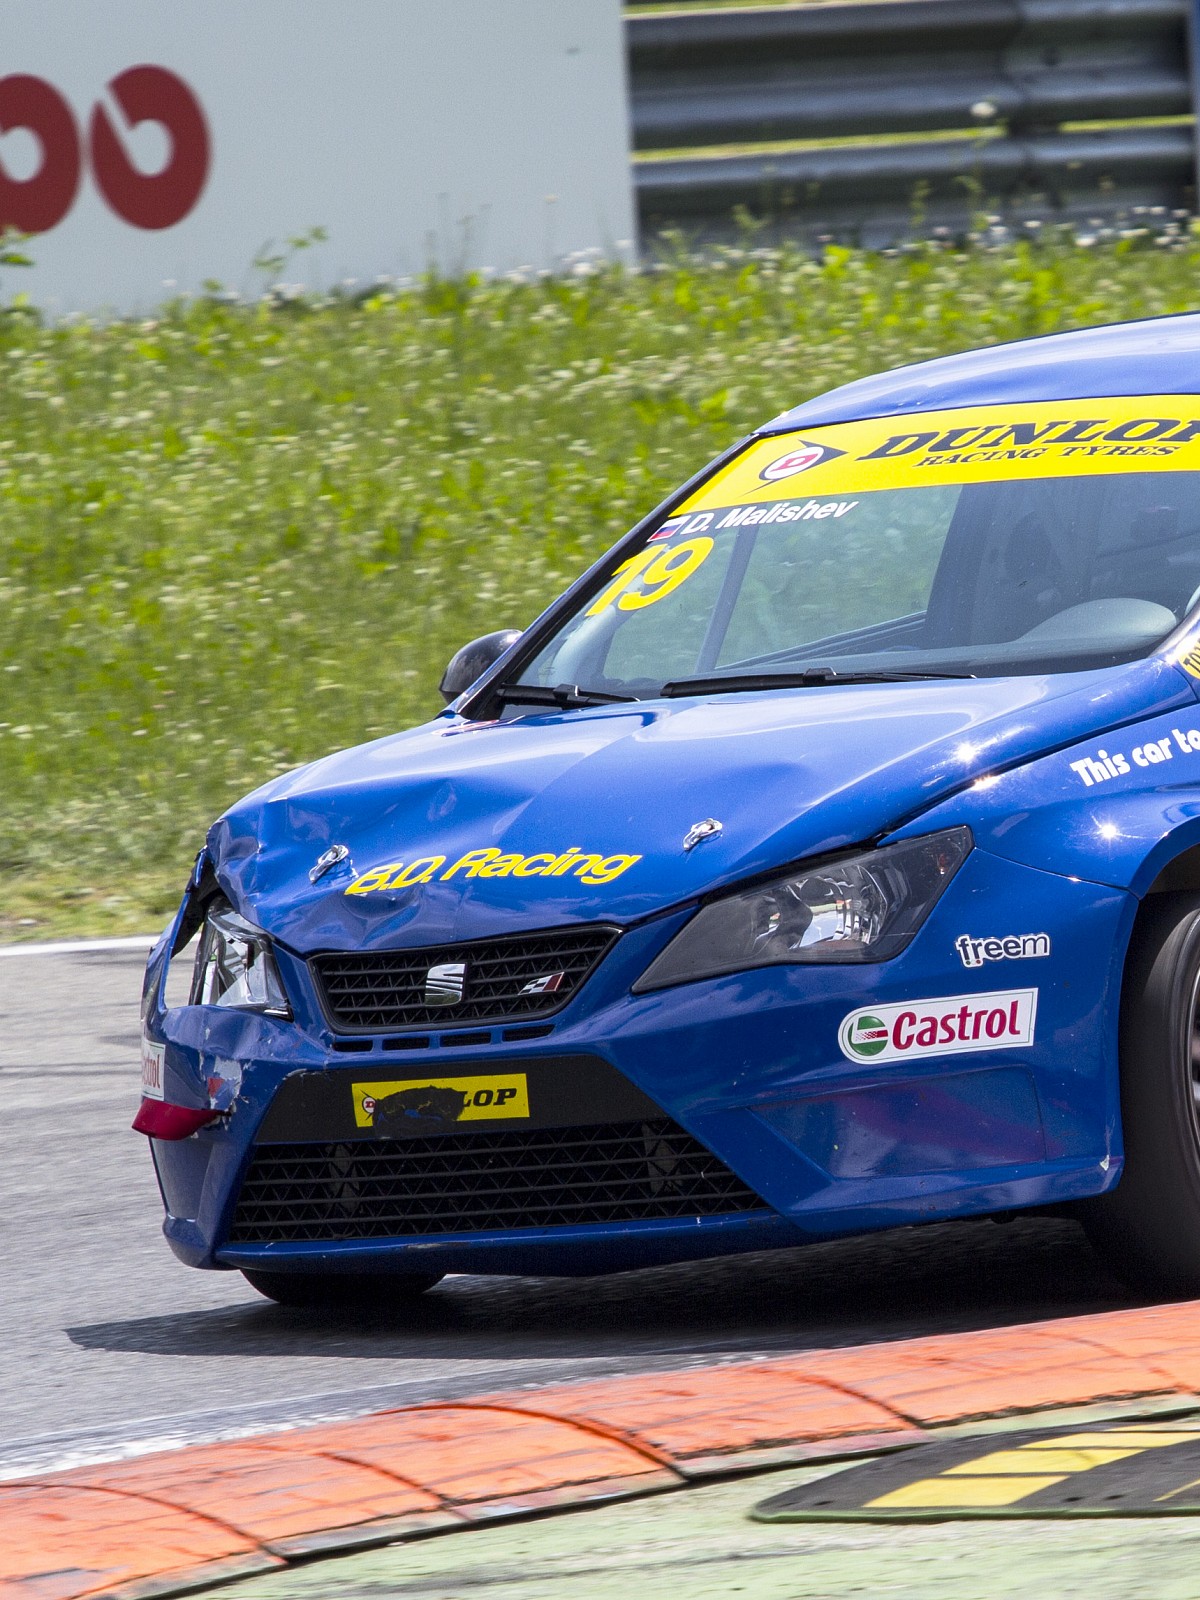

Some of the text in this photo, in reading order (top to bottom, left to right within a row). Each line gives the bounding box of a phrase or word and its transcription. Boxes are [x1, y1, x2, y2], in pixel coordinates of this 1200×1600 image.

[912, 443, 1182, 468] RACING TYRES
[680, 500, 859, 535] D. Malishev
[584, 536, 715, 617] 19
[1069, 750, 1131, 787] This
[1131, 737, 1172, 767] car
[439, 847, 643, 884] Racing
[958, 934, 1049, 960] freem
[892, 1000, 1021, 1050] Castrol
